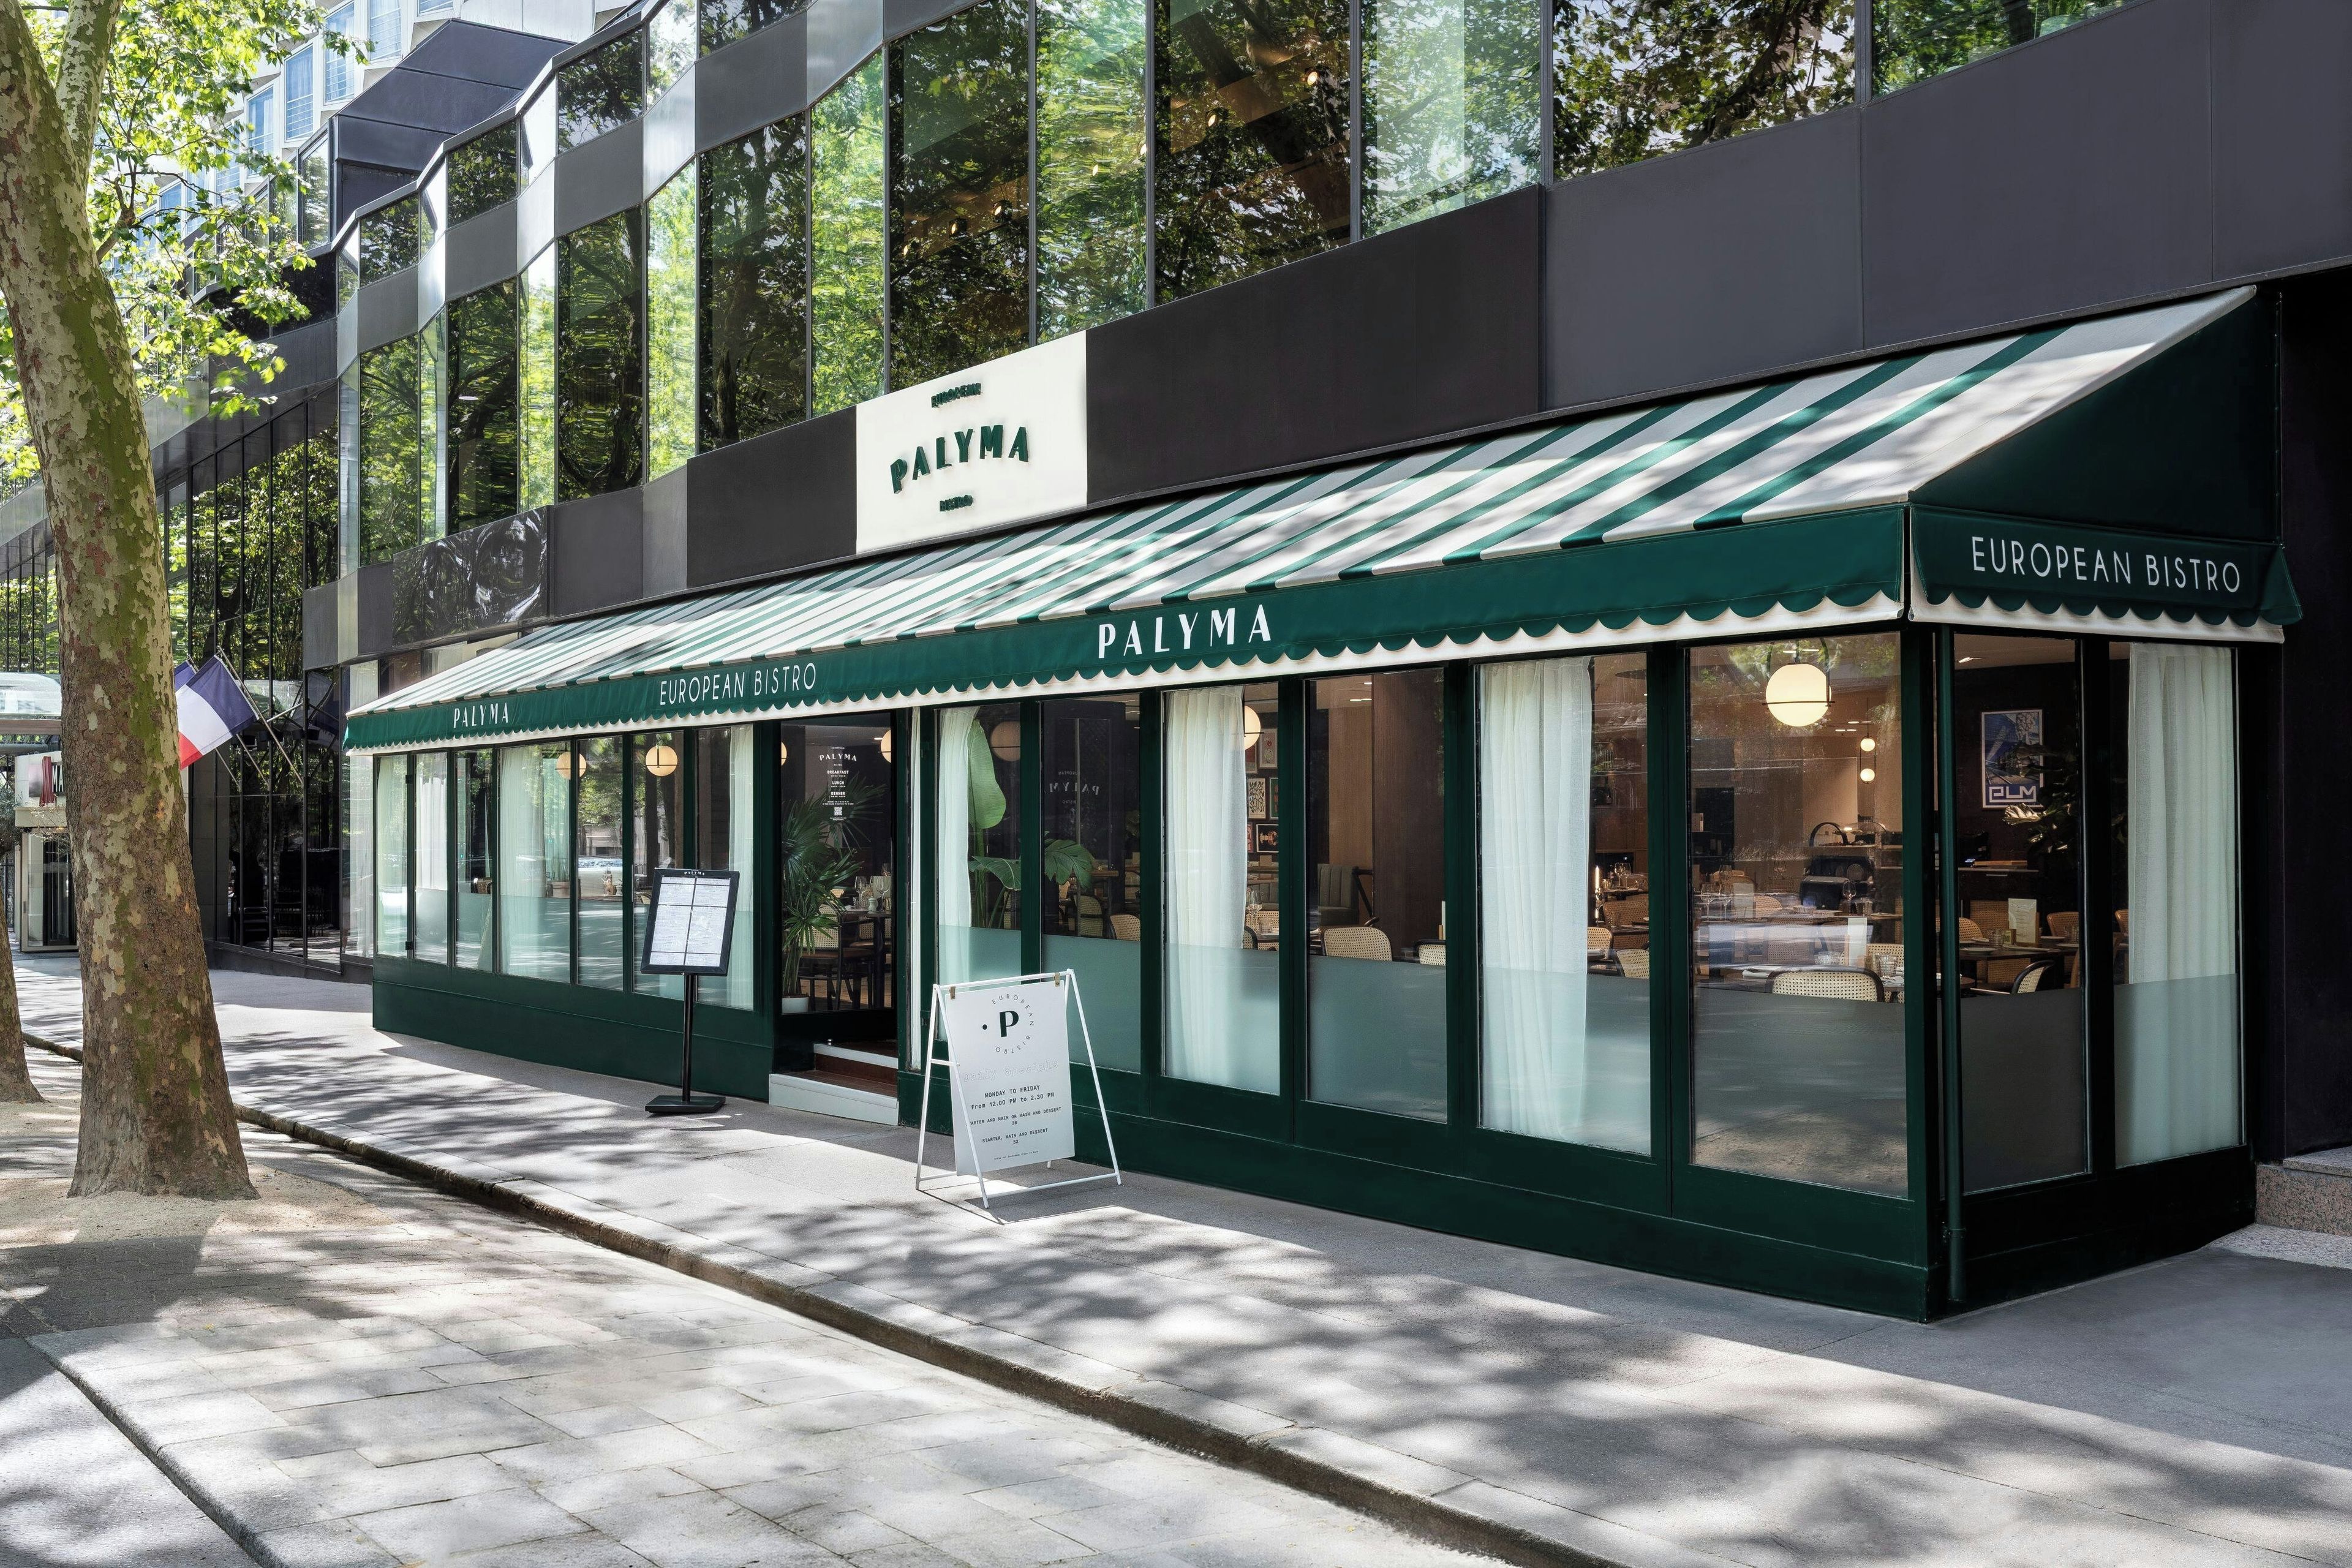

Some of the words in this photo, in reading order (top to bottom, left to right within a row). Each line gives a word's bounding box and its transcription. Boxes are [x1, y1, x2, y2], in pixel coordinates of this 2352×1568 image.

[890, 424, 1029, 494] PALYMA
[1972, 536, 2131, 584] EUROPEAN
[2146, 554, 2240, 593] BISTRO
[1098, 604, 1271, 658] PALYMA
[660, 673, 745, 706] EUROPEAN
[754, 662, 816, 696] BISTRO
[453, 702, 509, 728] PALYMA
[992, 994, 1034, 1026] EUROPEAN
[1000, 1011, 1019, 1038] P
[995, 1035, 1031, 1054] BISTRO
[963, 1068, 997, 1082] Daily
[1004, 1058, 1059, 1077] Specials
